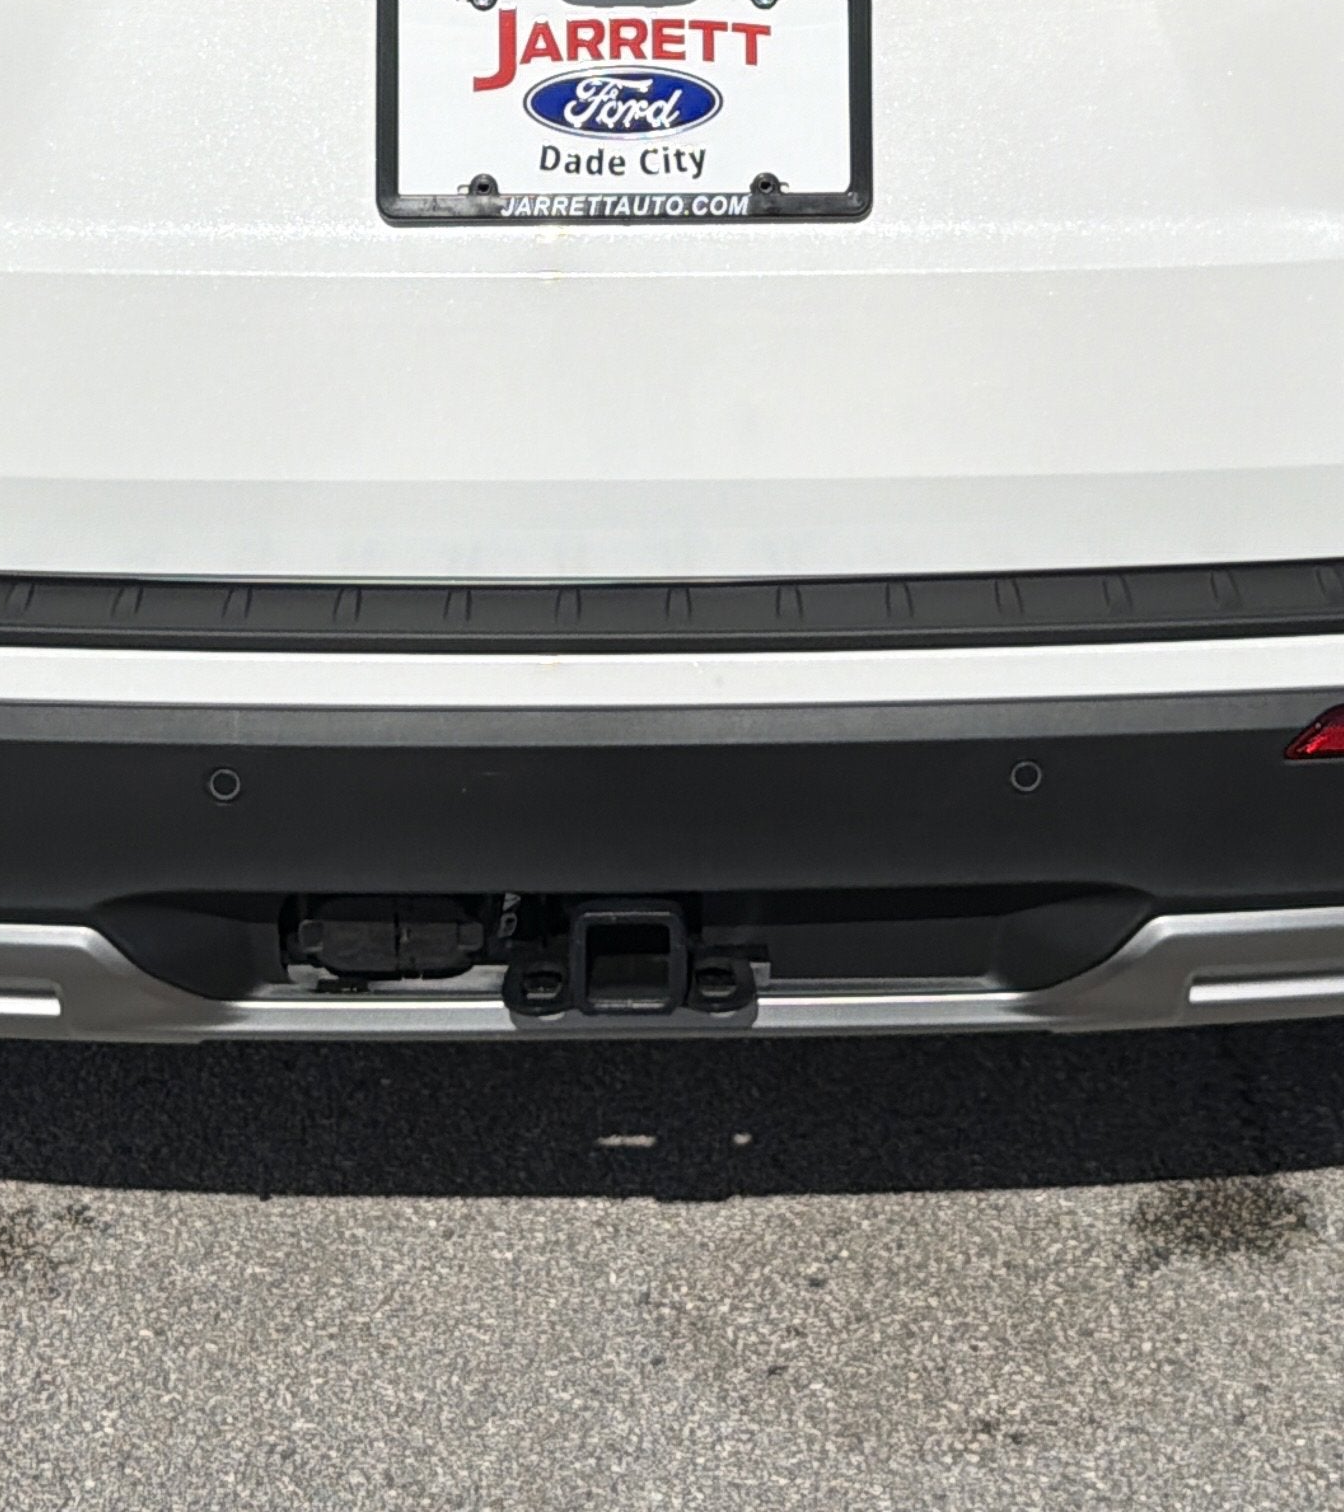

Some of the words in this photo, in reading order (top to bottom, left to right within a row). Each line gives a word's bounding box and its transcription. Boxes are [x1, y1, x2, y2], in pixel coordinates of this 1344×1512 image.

[472, 6, 772, 93] JARRETT
[563, 75, 683, 129] Ford
[538, 144, 626, 176] Dade
[639, 145, 708, 180] City
[500, 194, 750, 217] JARRETTAUTO.COM
